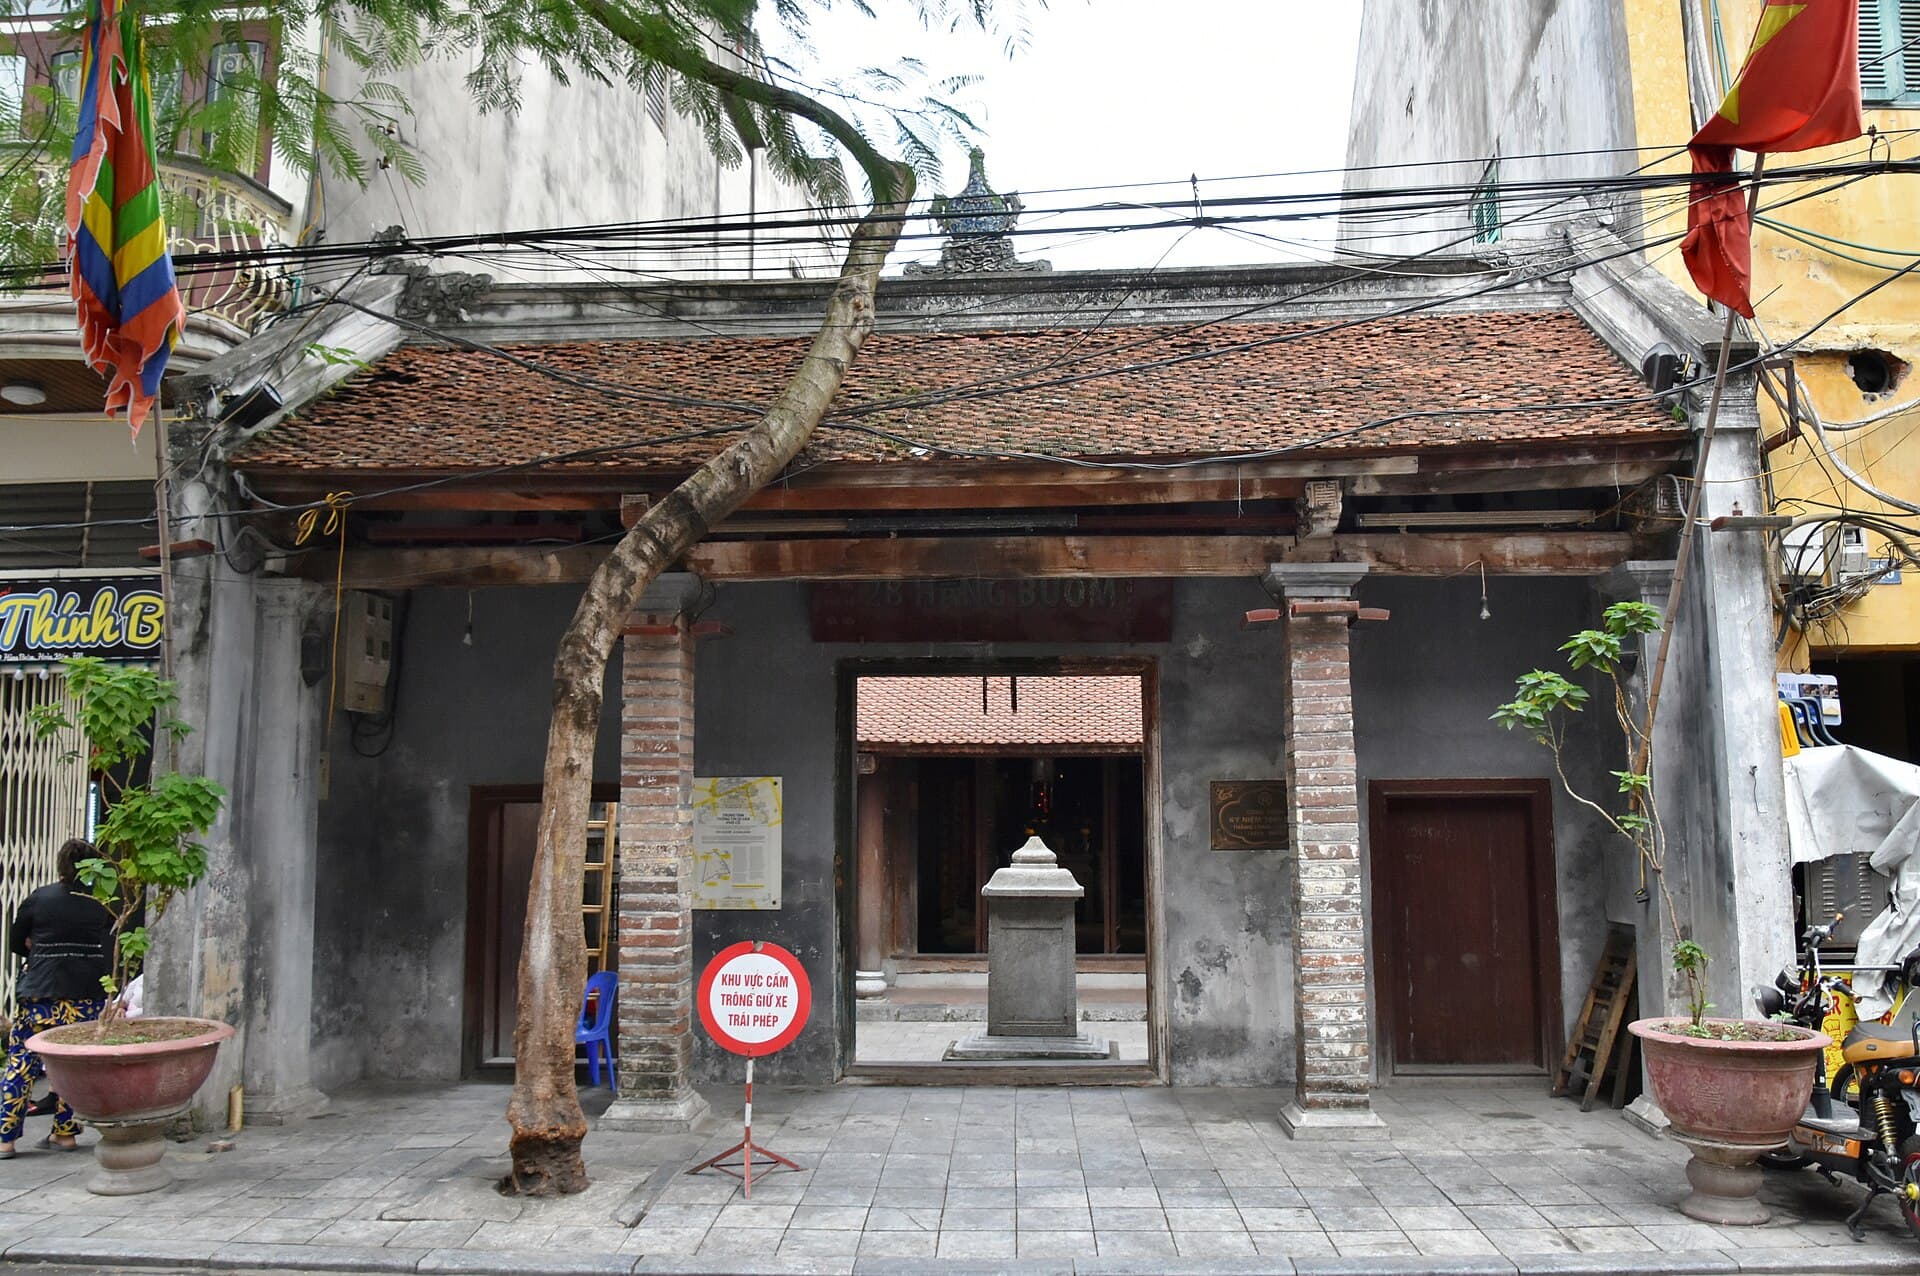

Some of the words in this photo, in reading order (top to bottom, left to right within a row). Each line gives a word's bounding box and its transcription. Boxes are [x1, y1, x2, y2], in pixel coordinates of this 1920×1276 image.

[122, 592, 165, 647] B
[721, 973, 741, 986] KHU
[744, 973, 763, 990] VỰC
[766, 970, 789, 988] CẤM
[756, 992, 774, 1008] GIỮ
[775, 995, 788, 1008] XE
[728, 1011, 750, 1027] TRÁI
[752, 1012, 779, 1028] PHÉP
